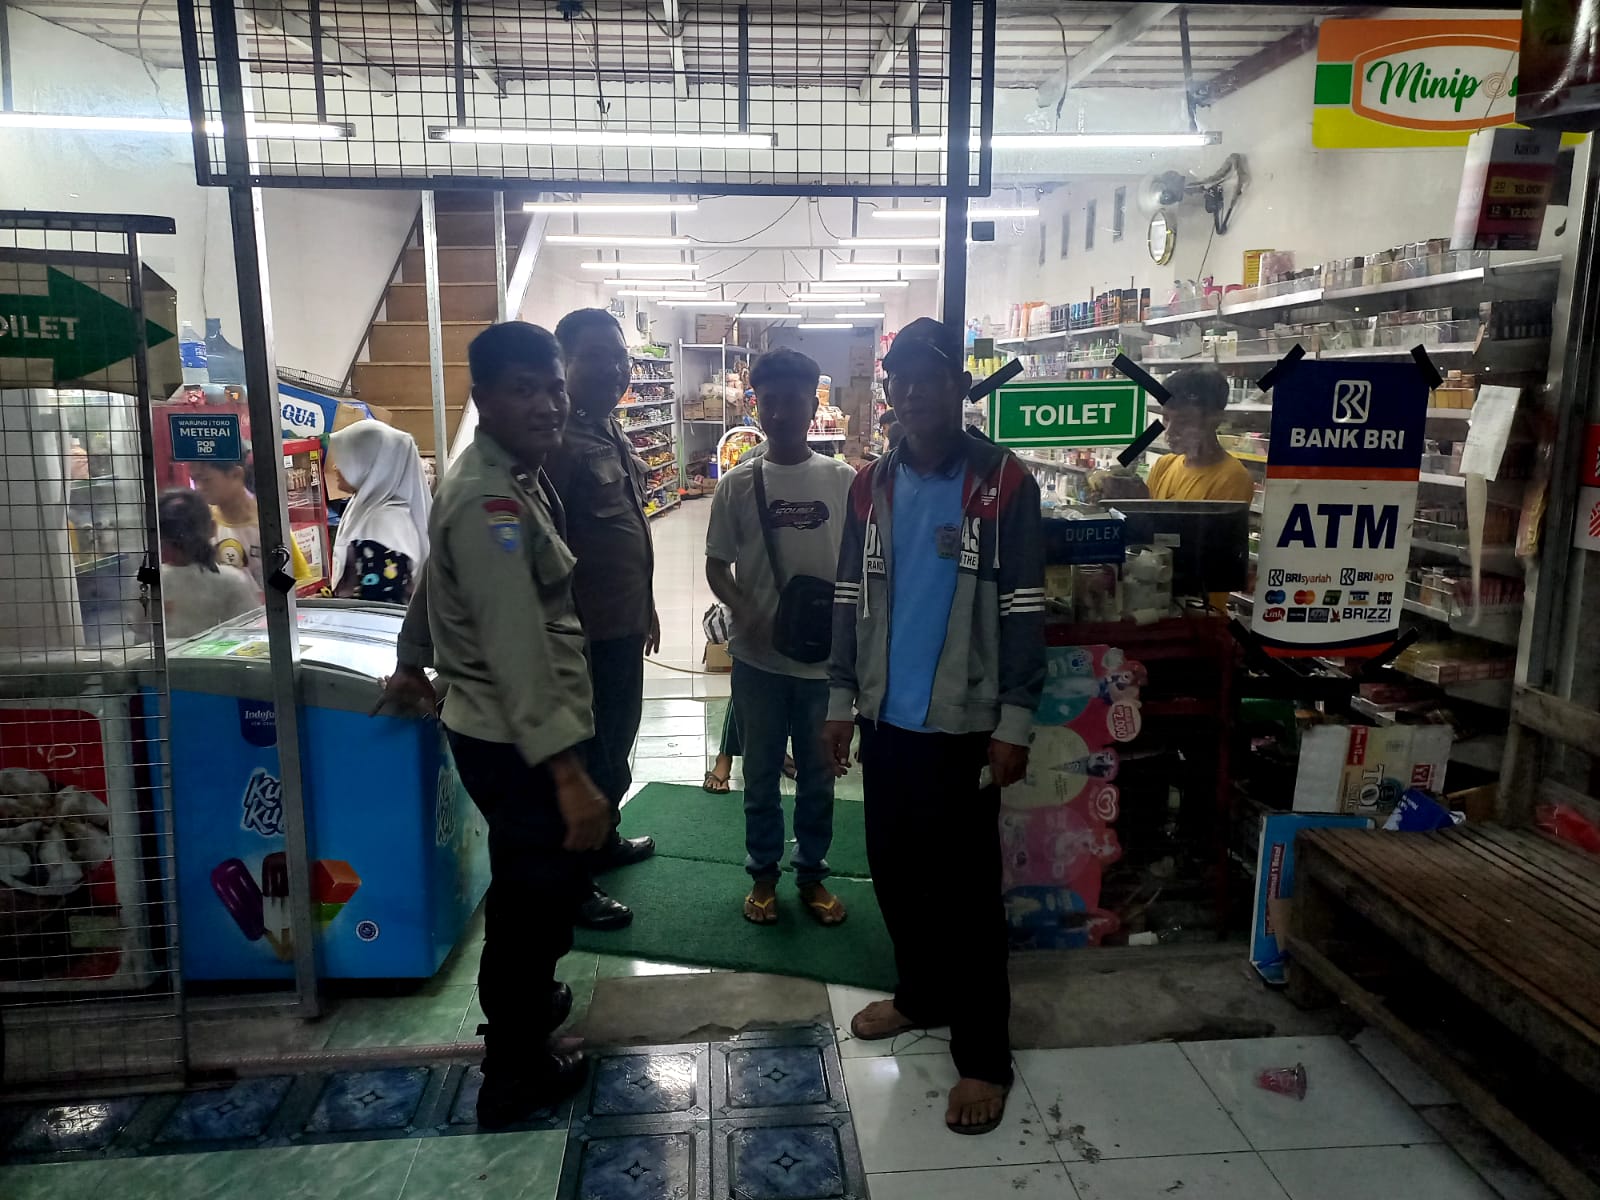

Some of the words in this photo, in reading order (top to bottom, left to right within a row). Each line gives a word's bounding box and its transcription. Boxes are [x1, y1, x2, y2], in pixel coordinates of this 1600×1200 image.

[280, 403, 316, 428] QUA
[1019, 403, 1117, 426] TOILET
[180, 427, 231, 437] METERAI
[1290, 428, 1359, 449] BANK
[1363, 429, 1405, 449] BRI
[1065, 526, 1120, 541] DUPLEX
[1276, 503, 1399, 549] ATM
[1342, 607, 1391, 620] BRIZZI
